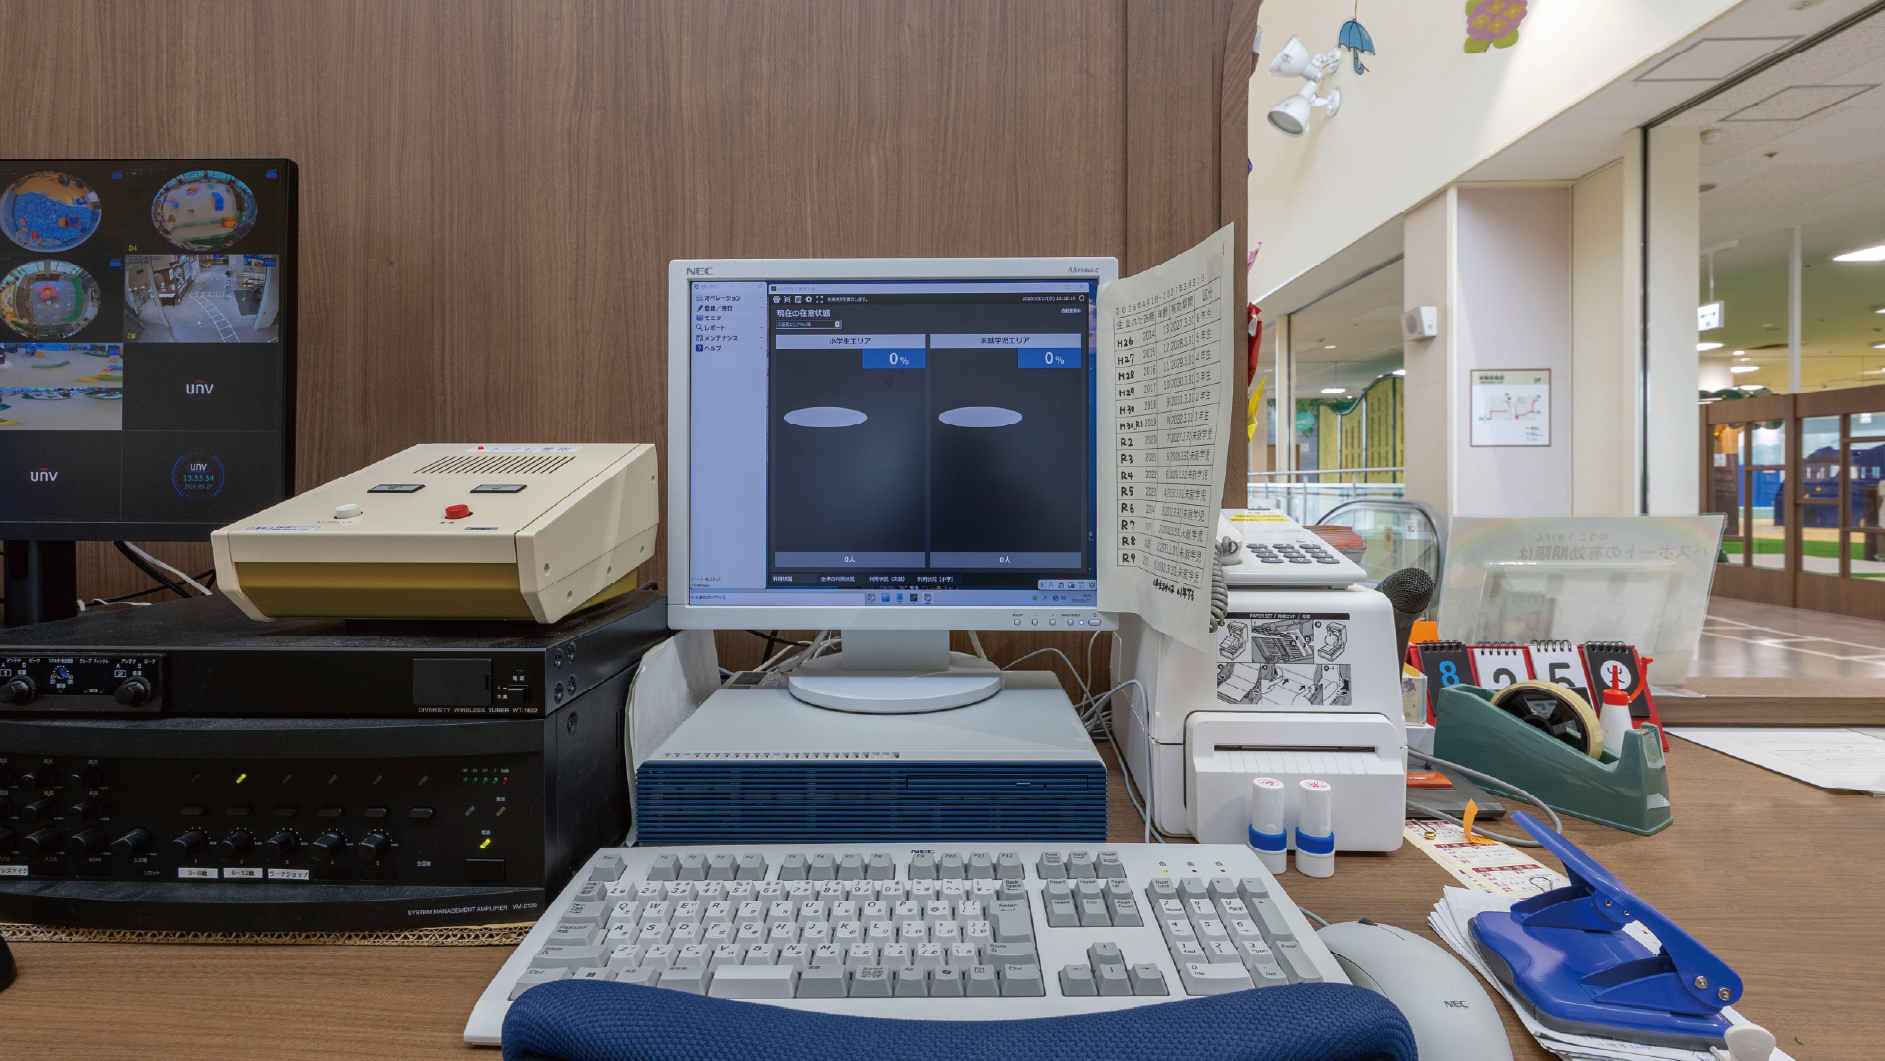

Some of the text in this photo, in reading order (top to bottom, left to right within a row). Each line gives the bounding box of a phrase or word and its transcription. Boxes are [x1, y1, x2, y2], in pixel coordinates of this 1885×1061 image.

[687, 267, 713, 275] NEC
[776, 309, 831, 317] 現在の在室状態
[829, 337, 1030, 345] 小学生エリア 未就学児エリア
[1117, 336, 1134, 348] H26
[1117, 354, 1135, 365] H27
[1118, 370, 1135, 381] H28
[1120, 438, 1134, 447] R2
[1120, 453, 1134, 464] R3
[1121, 471, 1134, 480] R4
[1121, 486, 1134, 497] R5
[1121, 503, 1135, 513] R6
[1121, 519, 1135, 530] R7
[1122, 536, 1136, 546] R8
[1122, 553, 1136, 563] R9
[1439, 661, 1460, 688] 8
[269, 870, 309, 878] ワークショップ
[407, 908, 433, 916] SYSTEM
[433, 906, 476, 915] MANAGEMENT
[476, 904, 508, 912] AMPLIFIER
[1443, 1000, 1469, 1009] NEC
